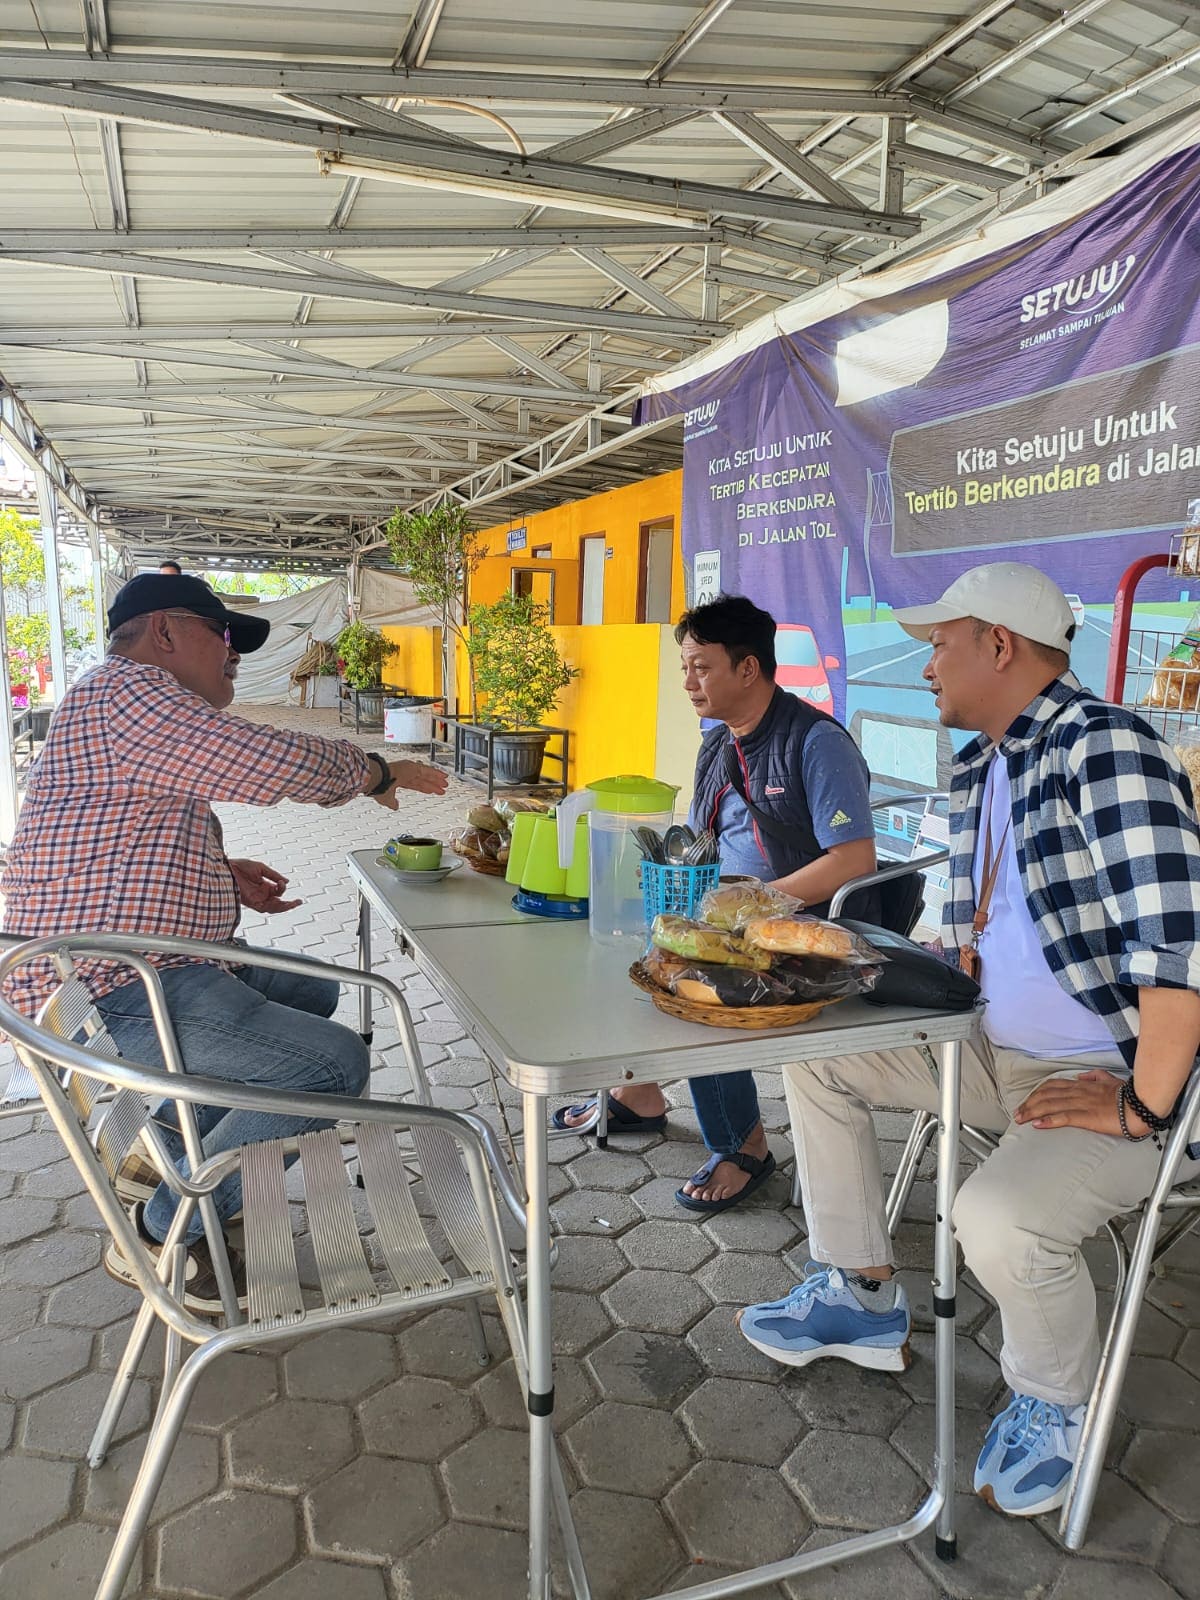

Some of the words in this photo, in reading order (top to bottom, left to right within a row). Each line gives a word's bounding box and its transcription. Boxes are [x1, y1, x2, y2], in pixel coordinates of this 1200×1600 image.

[1020, 260, 1119, 323] SETUJU
[1020, 328, 1057, 350] SELAMAT
[1058, 316, 1092, 337] SAMPAI
[684, 400, 716, 428] SETUJU
[708, 458, 731, 476] KITA
[734, 442, 782, 468] SETUJU
[786, 430, 833, 454] UNTUK
[956, 447, 997, 475] Kita
[1004, 427, 1084, 466] Setuju
[1094, 401, 1178, 447] Untuk
[710, 479, 745, 501] TERTIB
[748, 462, 831, 491] KECEPATAN
[905, 486, 958, 514] Tertib
[964, 463, 1100, 506] Berkendara
[1107, 453, 1130, 482] di
[736, 492, 836, 520] BERKENDARA
[758, 525, 806, 545] JALAN
[809, 521, 836, 539] TOL
